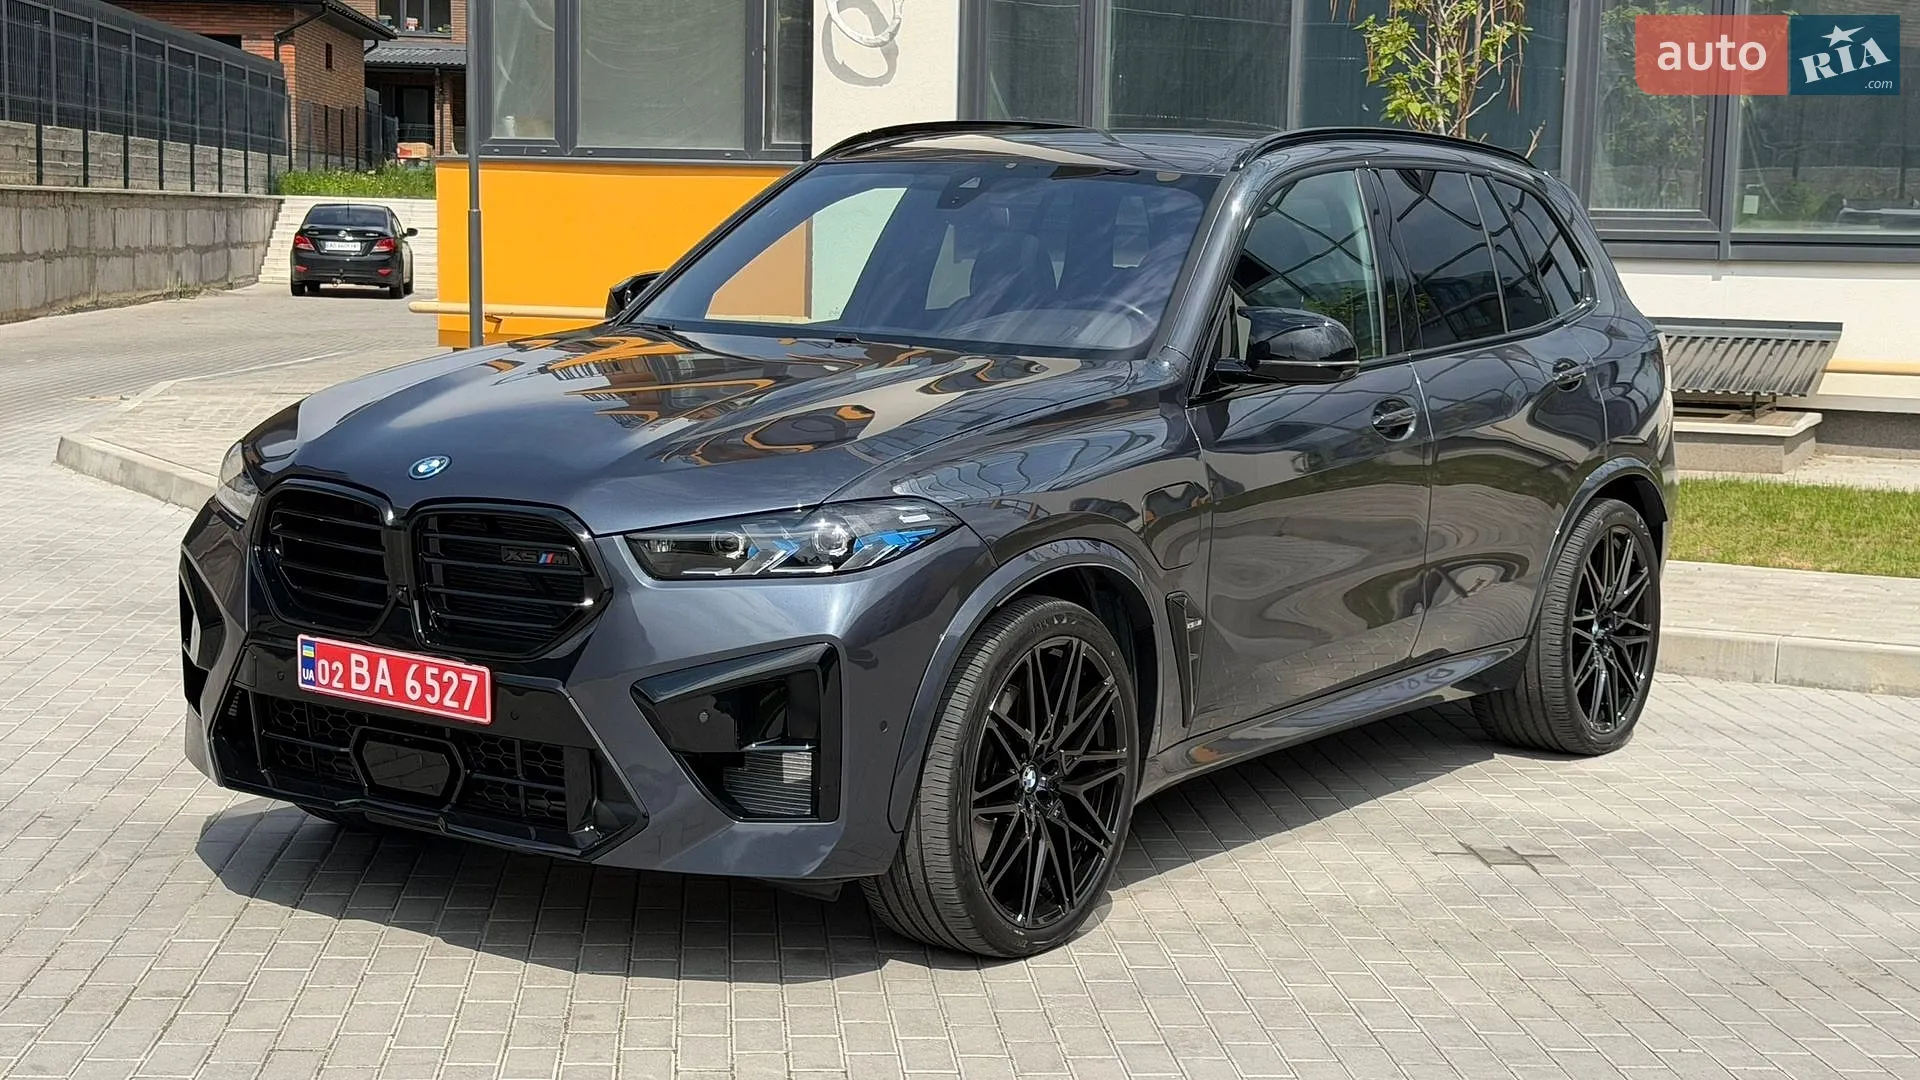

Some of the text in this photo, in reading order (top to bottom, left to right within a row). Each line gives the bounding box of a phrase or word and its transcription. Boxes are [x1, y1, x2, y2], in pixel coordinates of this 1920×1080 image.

[302, 668, 315, 682] UA
[317, 653, 479, 711] 02 BA 6527
